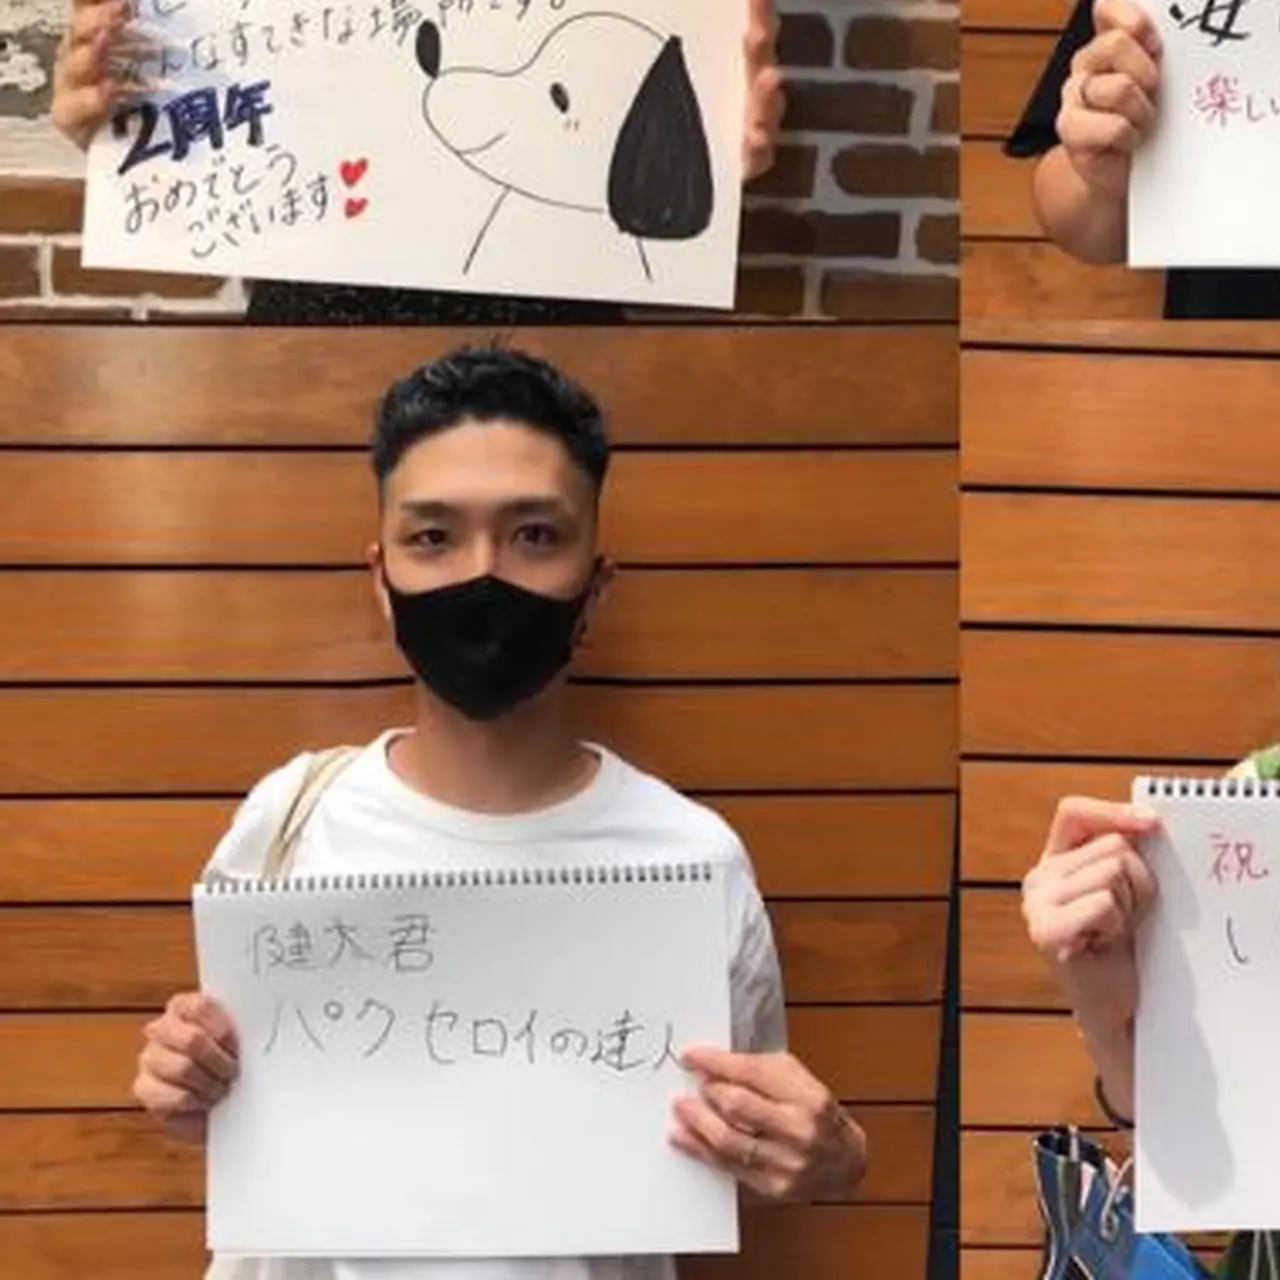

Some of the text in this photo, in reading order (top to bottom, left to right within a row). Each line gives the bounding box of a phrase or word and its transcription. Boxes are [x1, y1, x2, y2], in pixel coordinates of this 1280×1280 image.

[110, 79, 274, 176] 2周年
[122, 143, 298, 235] おめでとう
